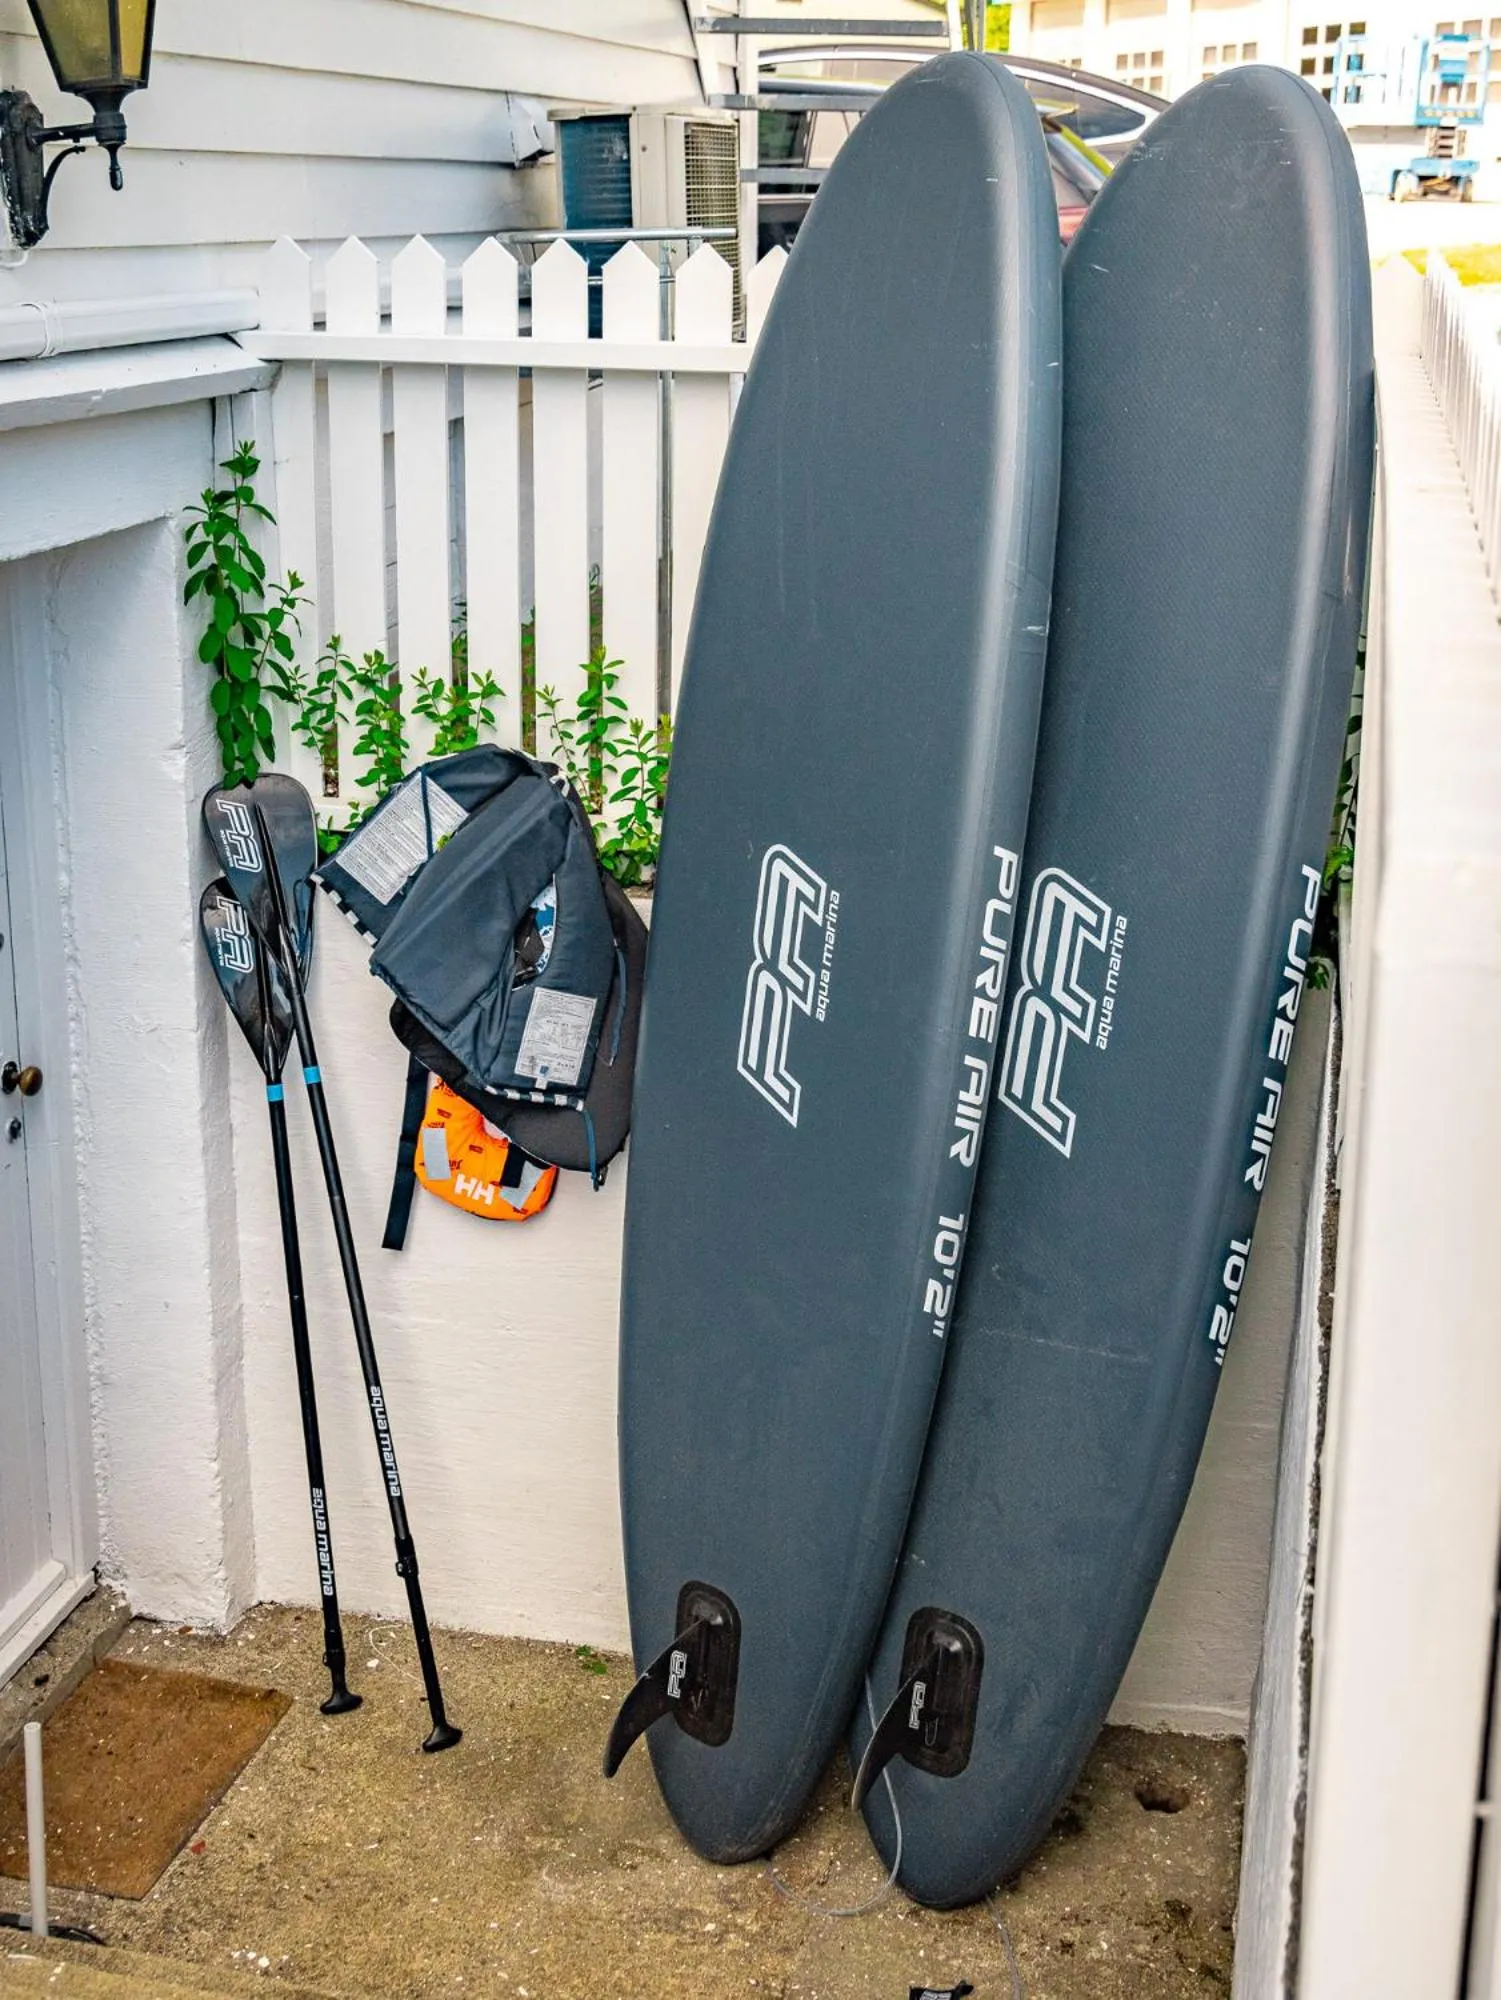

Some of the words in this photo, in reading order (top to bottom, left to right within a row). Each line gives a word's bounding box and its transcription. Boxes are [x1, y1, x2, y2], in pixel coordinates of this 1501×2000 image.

[823, 891, 840, 966] marina
[967, 845, 1019, 1045] PURE
[1095, 996, 1115, 1051] aqua
[1105, 916, 1127, 993] marina
[1268, 864, 1322, 1066] PURE
[816, 968, 832, 1022] aqua
[949, 1055, 989, 1168] AIR
[1244, 1077, 1283, 1192] AIR
[454, 1173, 495, 1206] HH
[923, 1213, 965, 1338] 10'2"
[1208, 1238, 1251, 1366] 10'2"
[370, 1386, 388, 1430] aqua
[379, 1433, 401, 1497] marina
[312, 1487, 326, 1531] aqua
[317, 1534, 335, 1596] marina
